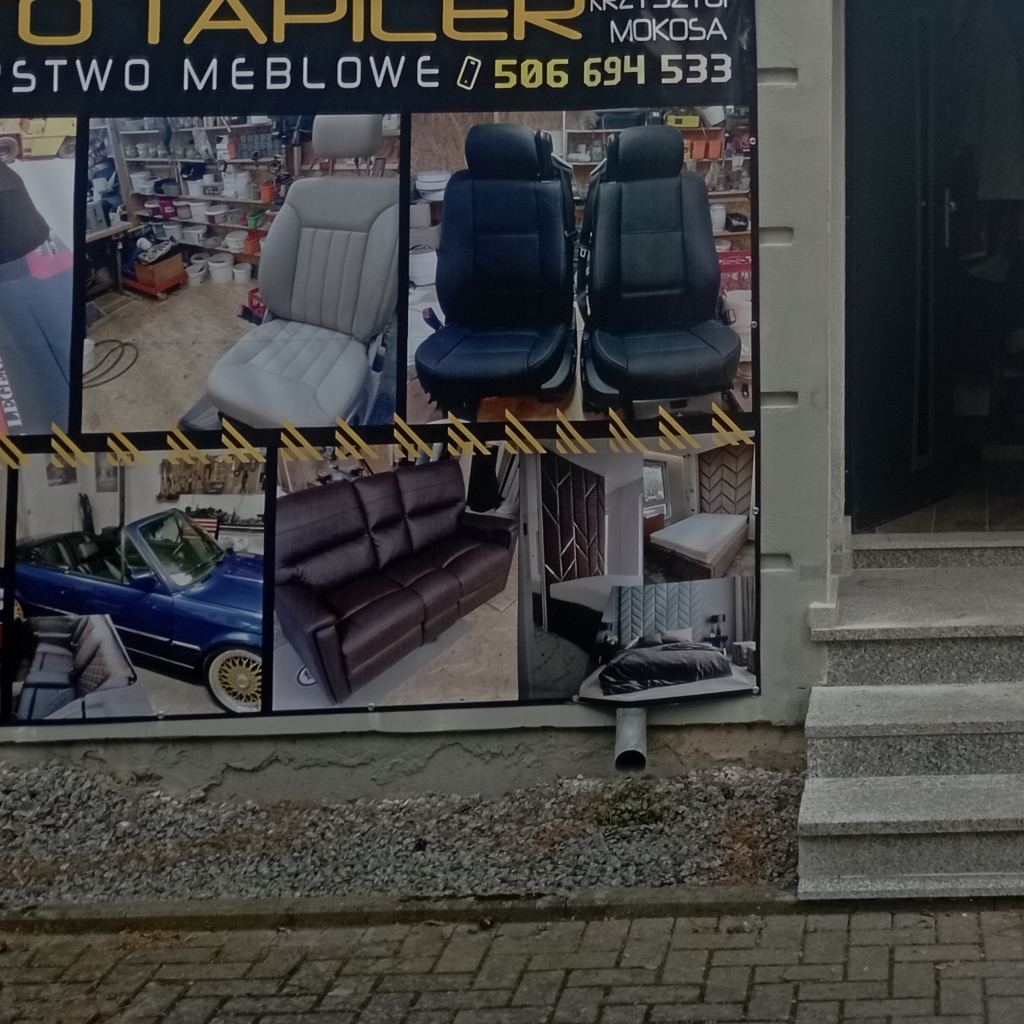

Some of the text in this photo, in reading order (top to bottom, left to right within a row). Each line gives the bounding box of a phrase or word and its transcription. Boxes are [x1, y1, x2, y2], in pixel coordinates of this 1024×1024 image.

[610, 17, 728, 44] MOKOSA
[183, 55, 440, 91] MEBLOWE
[494, 58, 570, 89] 506
[583, 54, 646, 88] 694
[660, 53, 733, 84] 533
